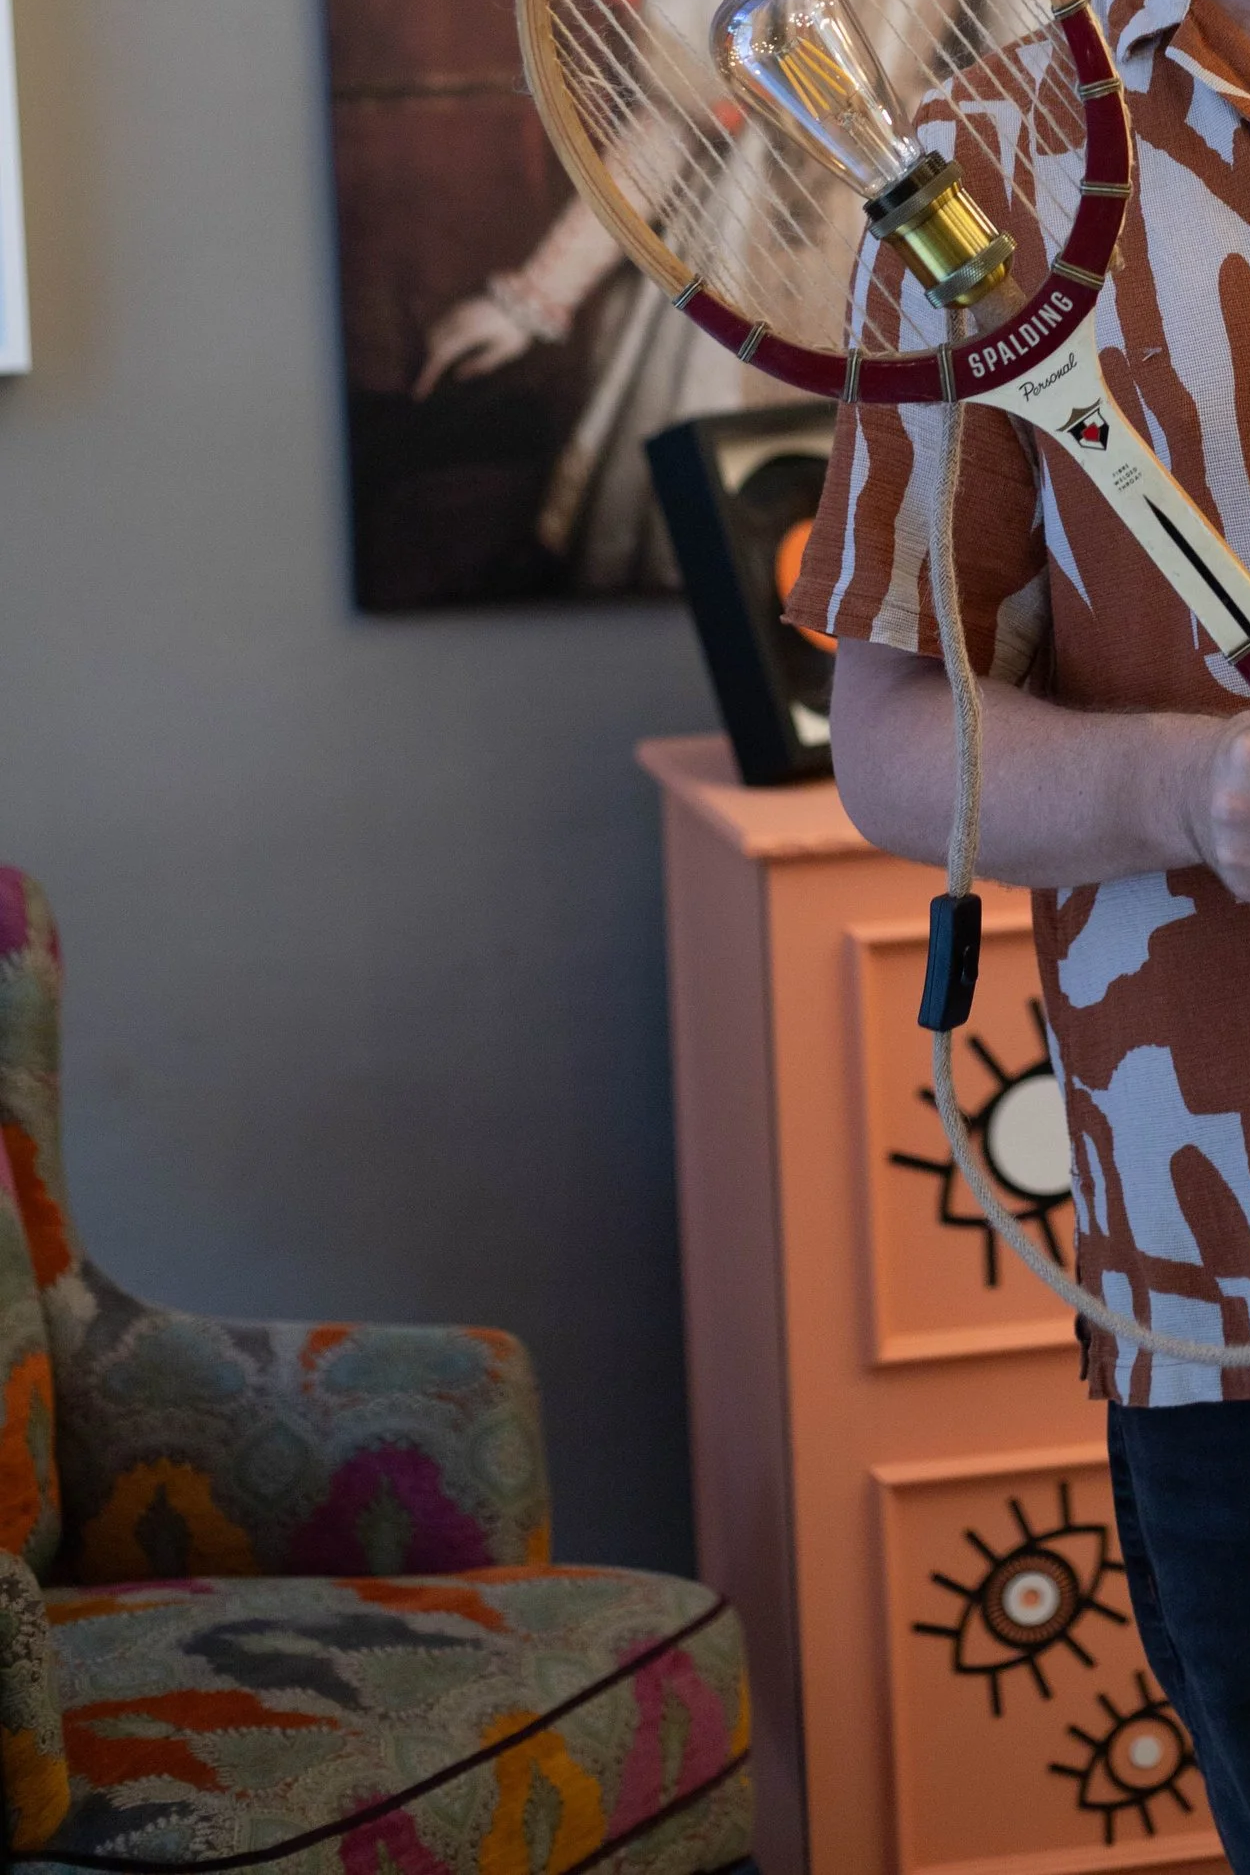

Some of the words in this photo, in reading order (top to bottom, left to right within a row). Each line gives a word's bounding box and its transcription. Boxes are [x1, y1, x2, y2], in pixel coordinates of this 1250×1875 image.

[968, 291, 1073, 378] SPALDING
[1019, 352, 1077, 402] Personal
[1114, 466, 1138, 486] WELDED
[1118, 471, 1142, 491] THROAT
